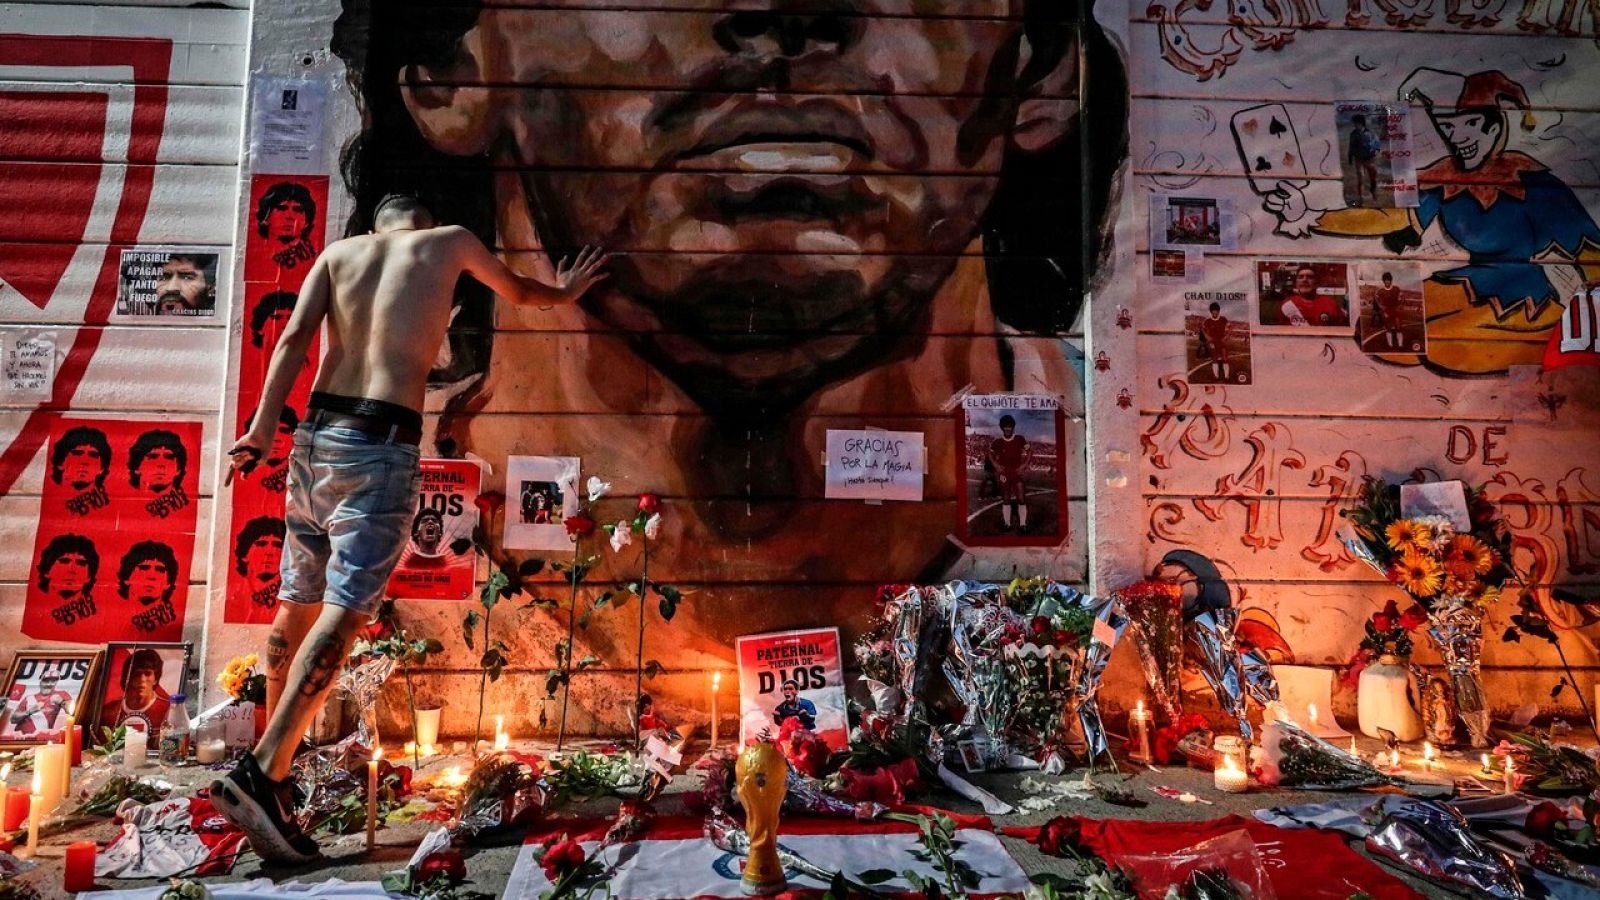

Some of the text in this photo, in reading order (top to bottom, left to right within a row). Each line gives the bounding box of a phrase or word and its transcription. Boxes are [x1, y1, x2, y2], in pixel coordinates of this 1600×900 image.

[123, 253, 171, 263] IMPOSIBLE
[127, 266, 164, 276] APAGAR
[130, 279, 157, 290] TANTO
[128, 293, 158, 302] FUEGO
[1184, 291, 1211, 301] CHAU
[967, 396, 1057, 408] EL QUIJOTE TE AMA
[844, 438, 903, 457] GRACIAS
[1446, 424, 1509, 466] DE
[840, 455, 912, 475] POR LA MAGIA
[442, 484, 454, 492] DE
[757, 642, 824, 662] PATERNAL
[768, 656, 813, 669] TIERRA DE
